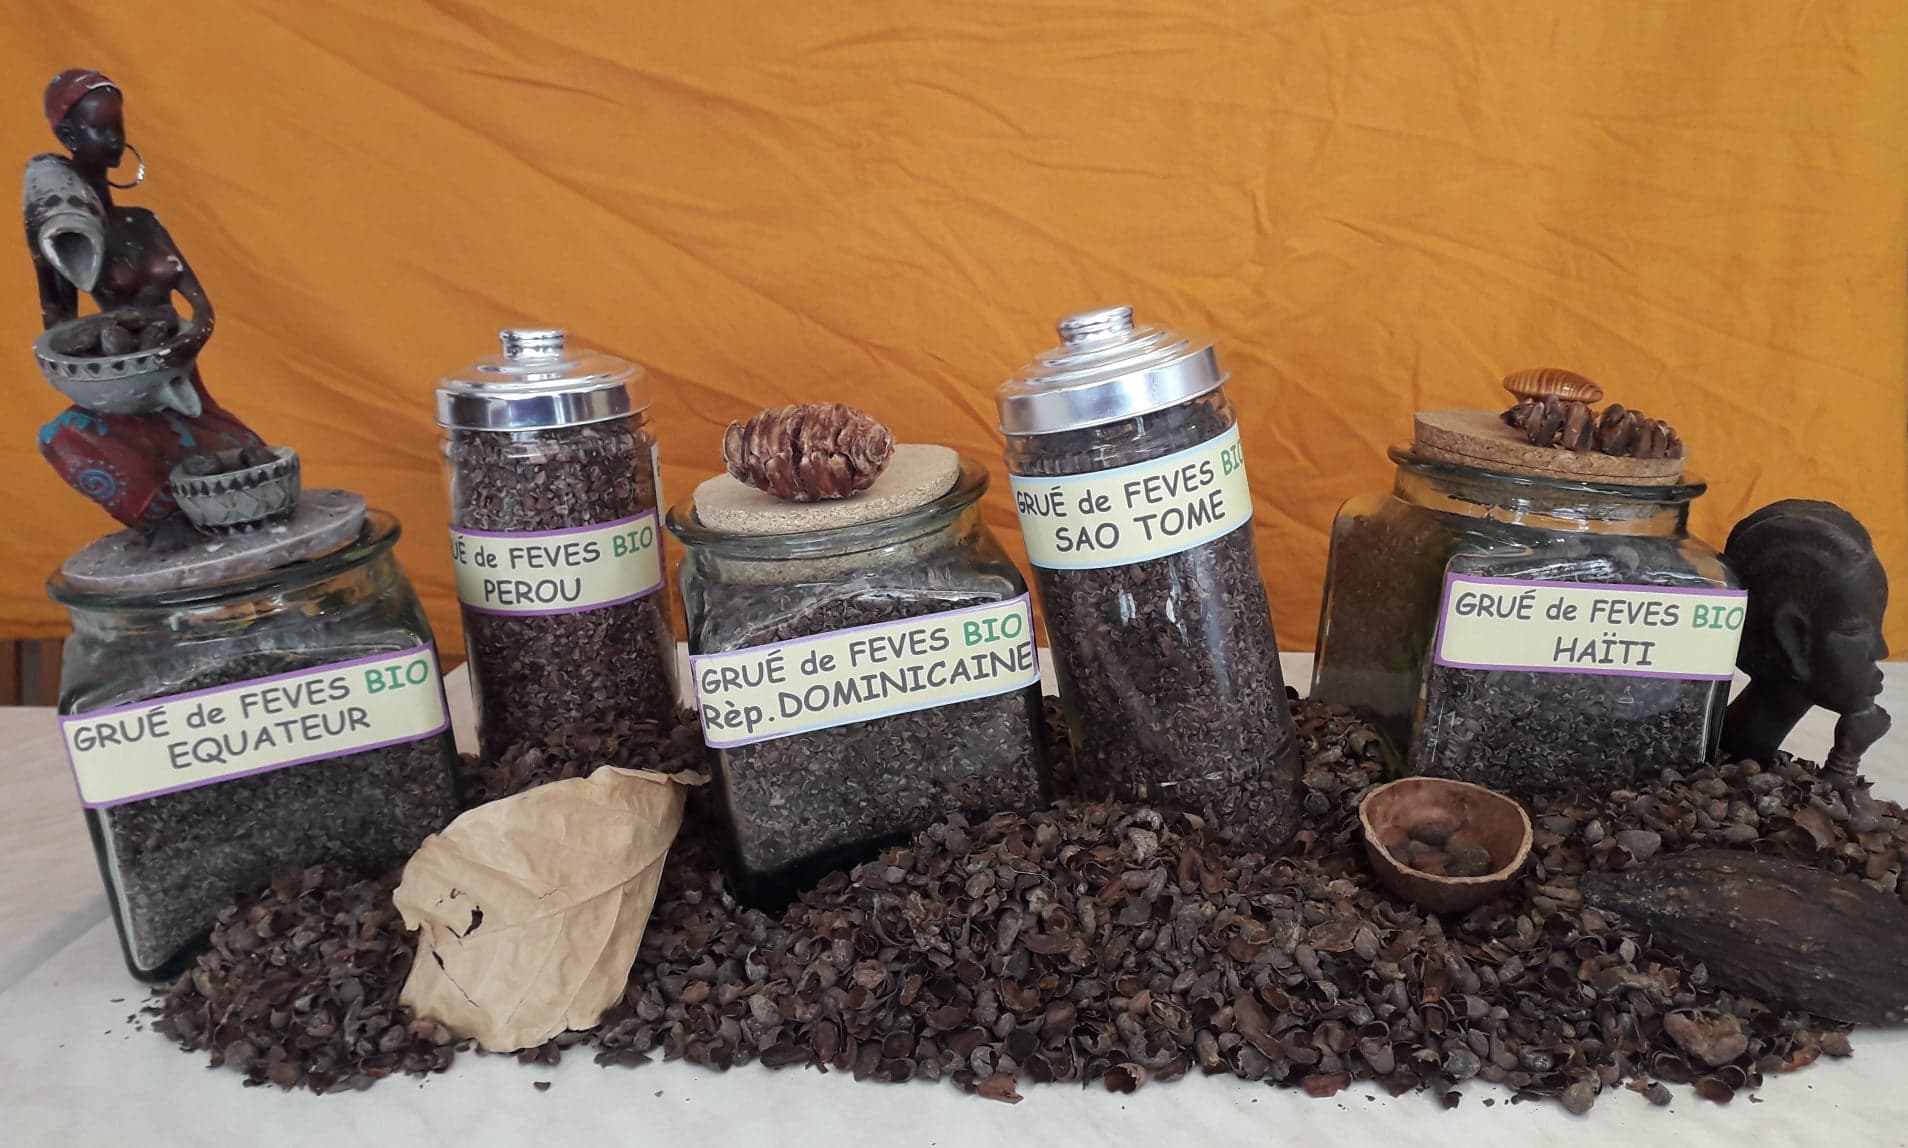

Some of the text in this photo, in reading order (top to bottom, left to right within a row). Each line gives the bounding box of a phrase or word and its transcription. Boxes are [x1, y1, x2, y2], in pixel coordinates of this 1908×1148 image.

[1017, 486, 1067, 518] GRUÉ
[1078, 489, 1112, 515] de
[1123, 460, 1214, 509] FEVES
[474, 546, 498, 569] de
[509, 541, 600, 570] FEVES
[612, 526, 653, 558] BIO
[1056, 489, 1226, 552] SAO TOME
[484, 577, 581, 605] PEROU
[1455, 589, 1745, 630] GRUÉ de FEVES BIO
[701, 613, 1022, 695] GRUÉ de FEVES BIO
[1552, 632, 1656, 666] HAÏTI
[73, 659, 429, 752] GRUÉ de FEVES BIO
[168, 707, 370, 770] EQUATEUR
